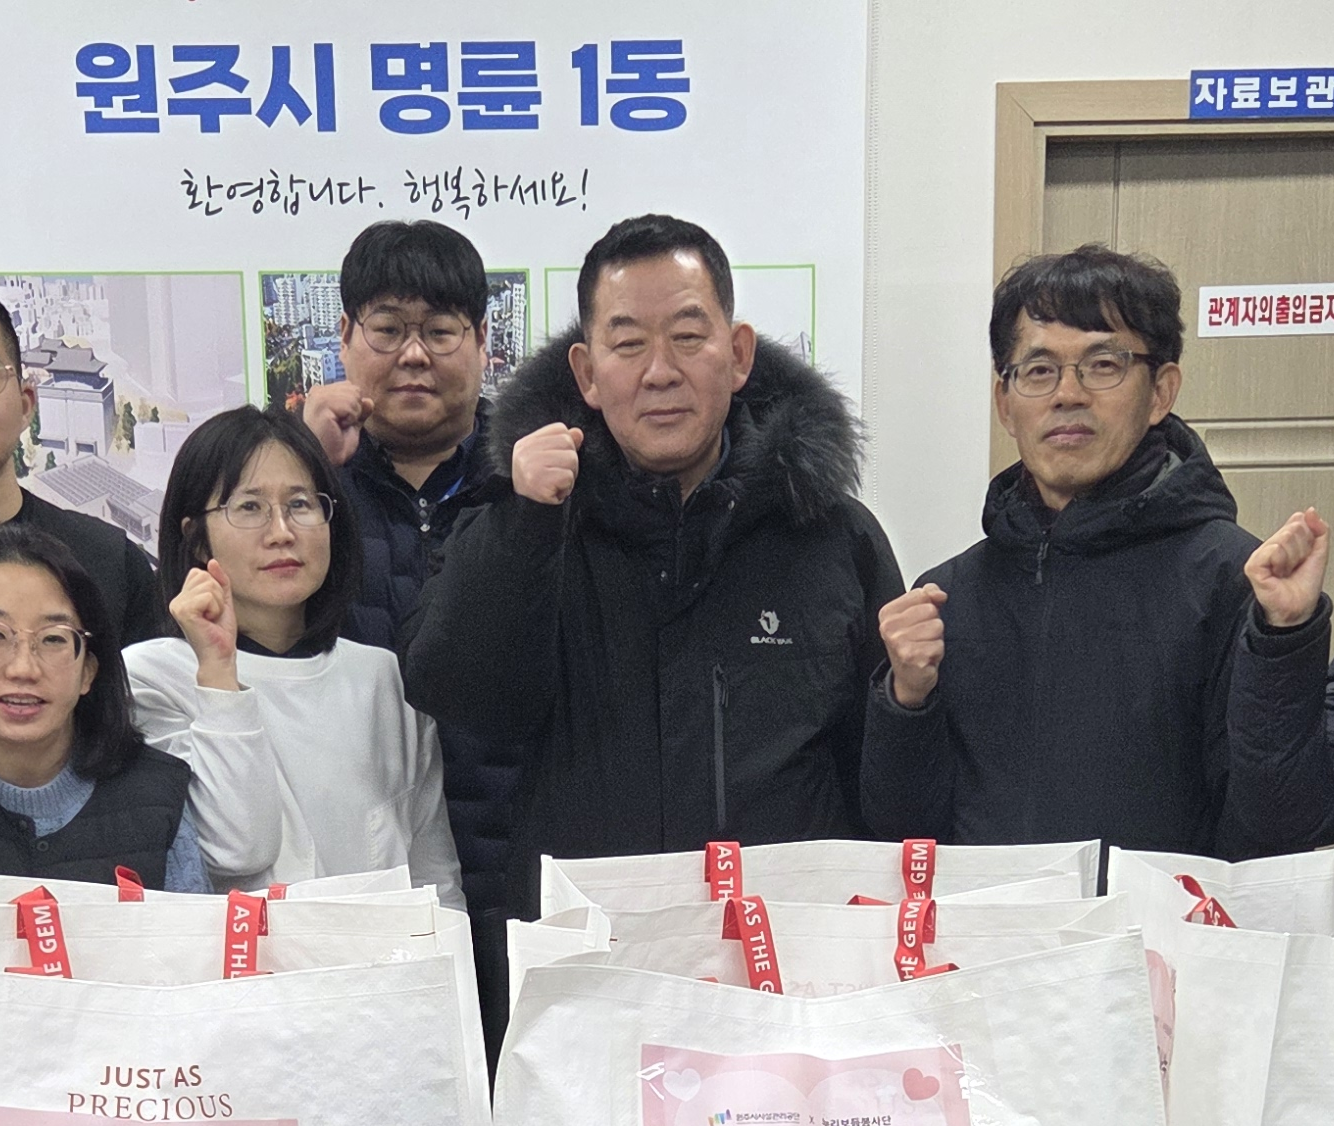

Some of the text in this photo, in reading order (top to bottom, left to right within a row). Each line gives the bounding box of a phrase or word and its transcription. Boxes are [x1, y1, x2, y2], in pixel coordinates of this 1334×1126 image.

[75, 39, 691, 135] 원주시 명륜 1동
[180, 168, 589, 220] 환영합니다. 행복하세요!
[910, 842, 929, 885] GEM
[31, 904, 58, 954] GEM
[232, 904, 250, 934] AS
[741, 900, 762, 927] AS
[903, 900, 921, 948] GEM
[749, 931, 771, 974] THE
[100, 1065, 203, 1090] JUST AS
[67, 1092, 234, 1122] PRECIOUS
